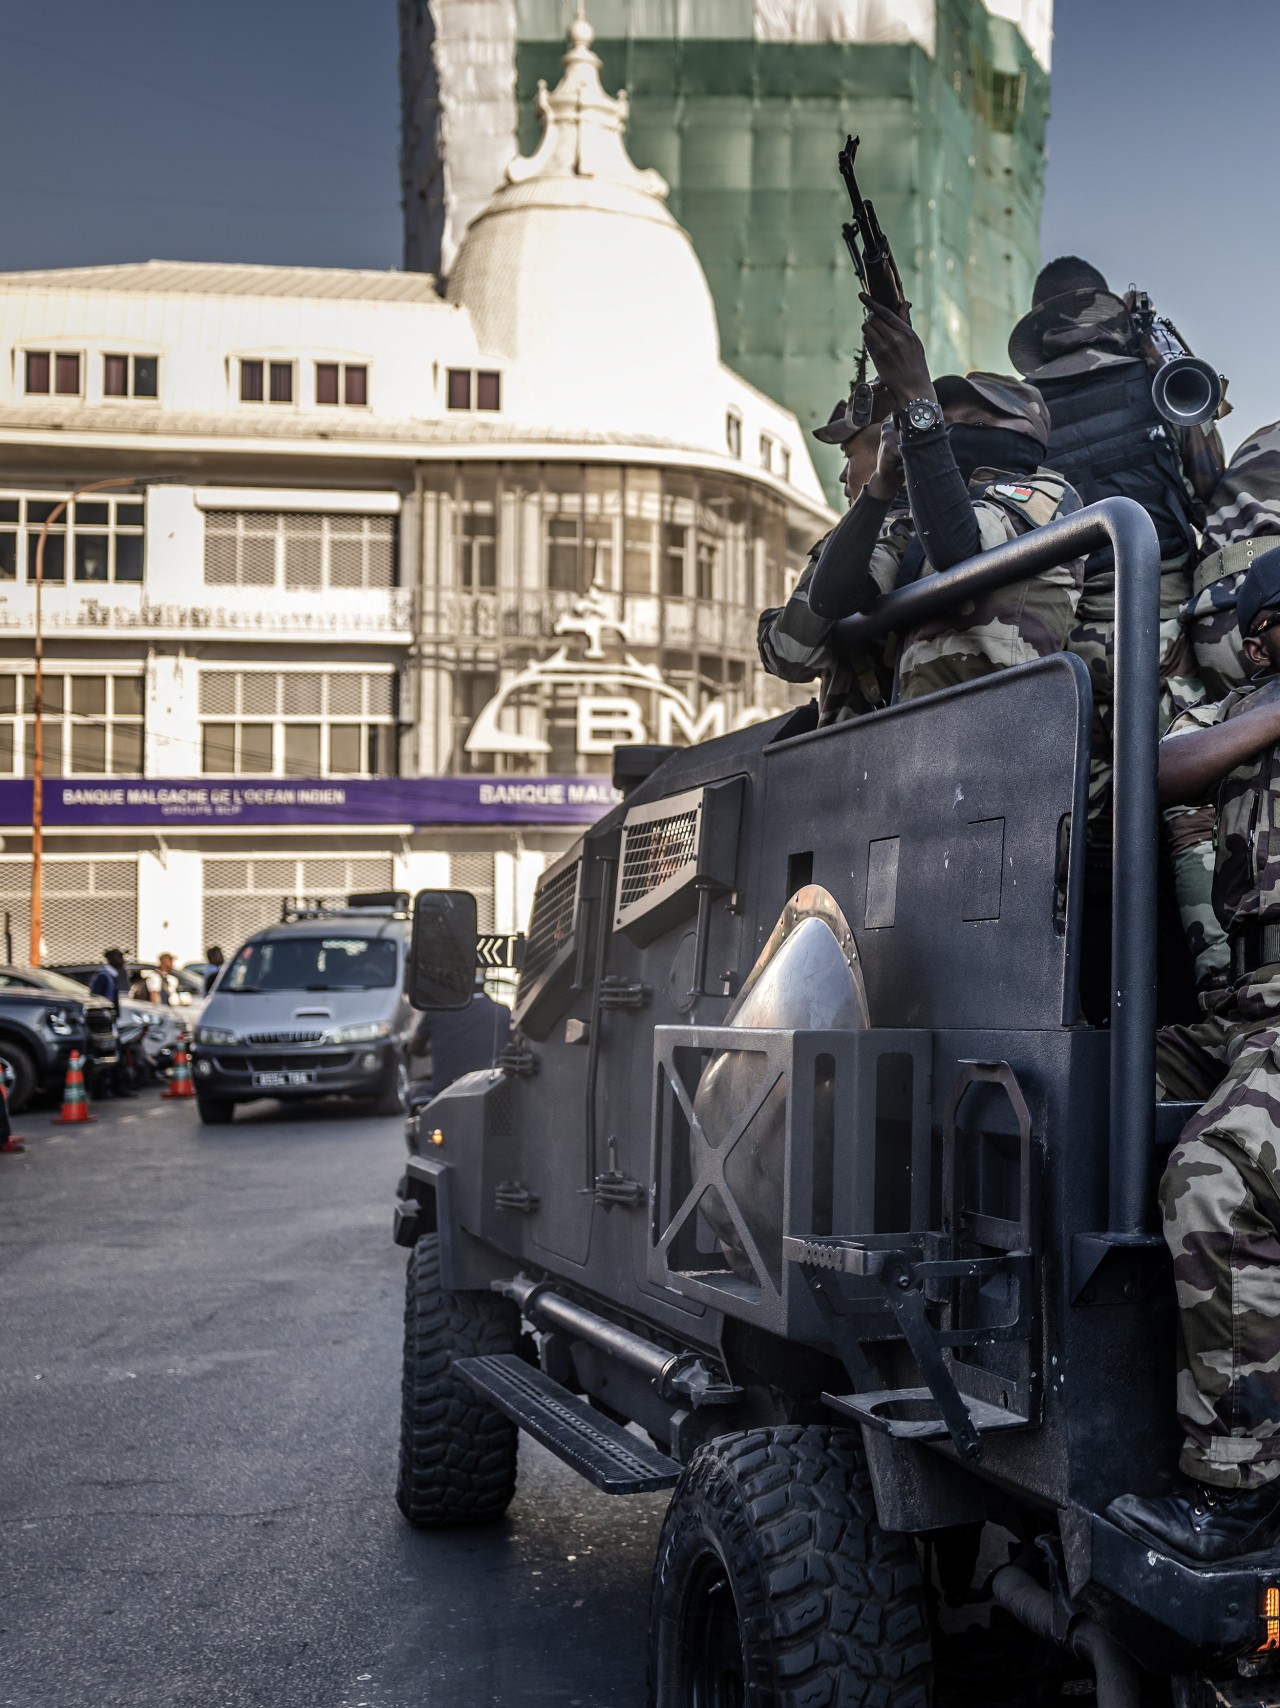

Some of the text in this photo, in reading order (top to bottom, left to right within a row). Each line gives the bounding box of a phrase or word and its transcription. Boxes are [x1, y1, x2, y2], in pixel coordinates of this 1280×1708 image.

[62, 788, 125, 806] BANQUE
[127, 788, 208, 805] MALGACHE
[210, 788, 232, 805] DE
[297, 788, 346, 805] INDIEN
[480, 784, 564, 805] BANQUE
